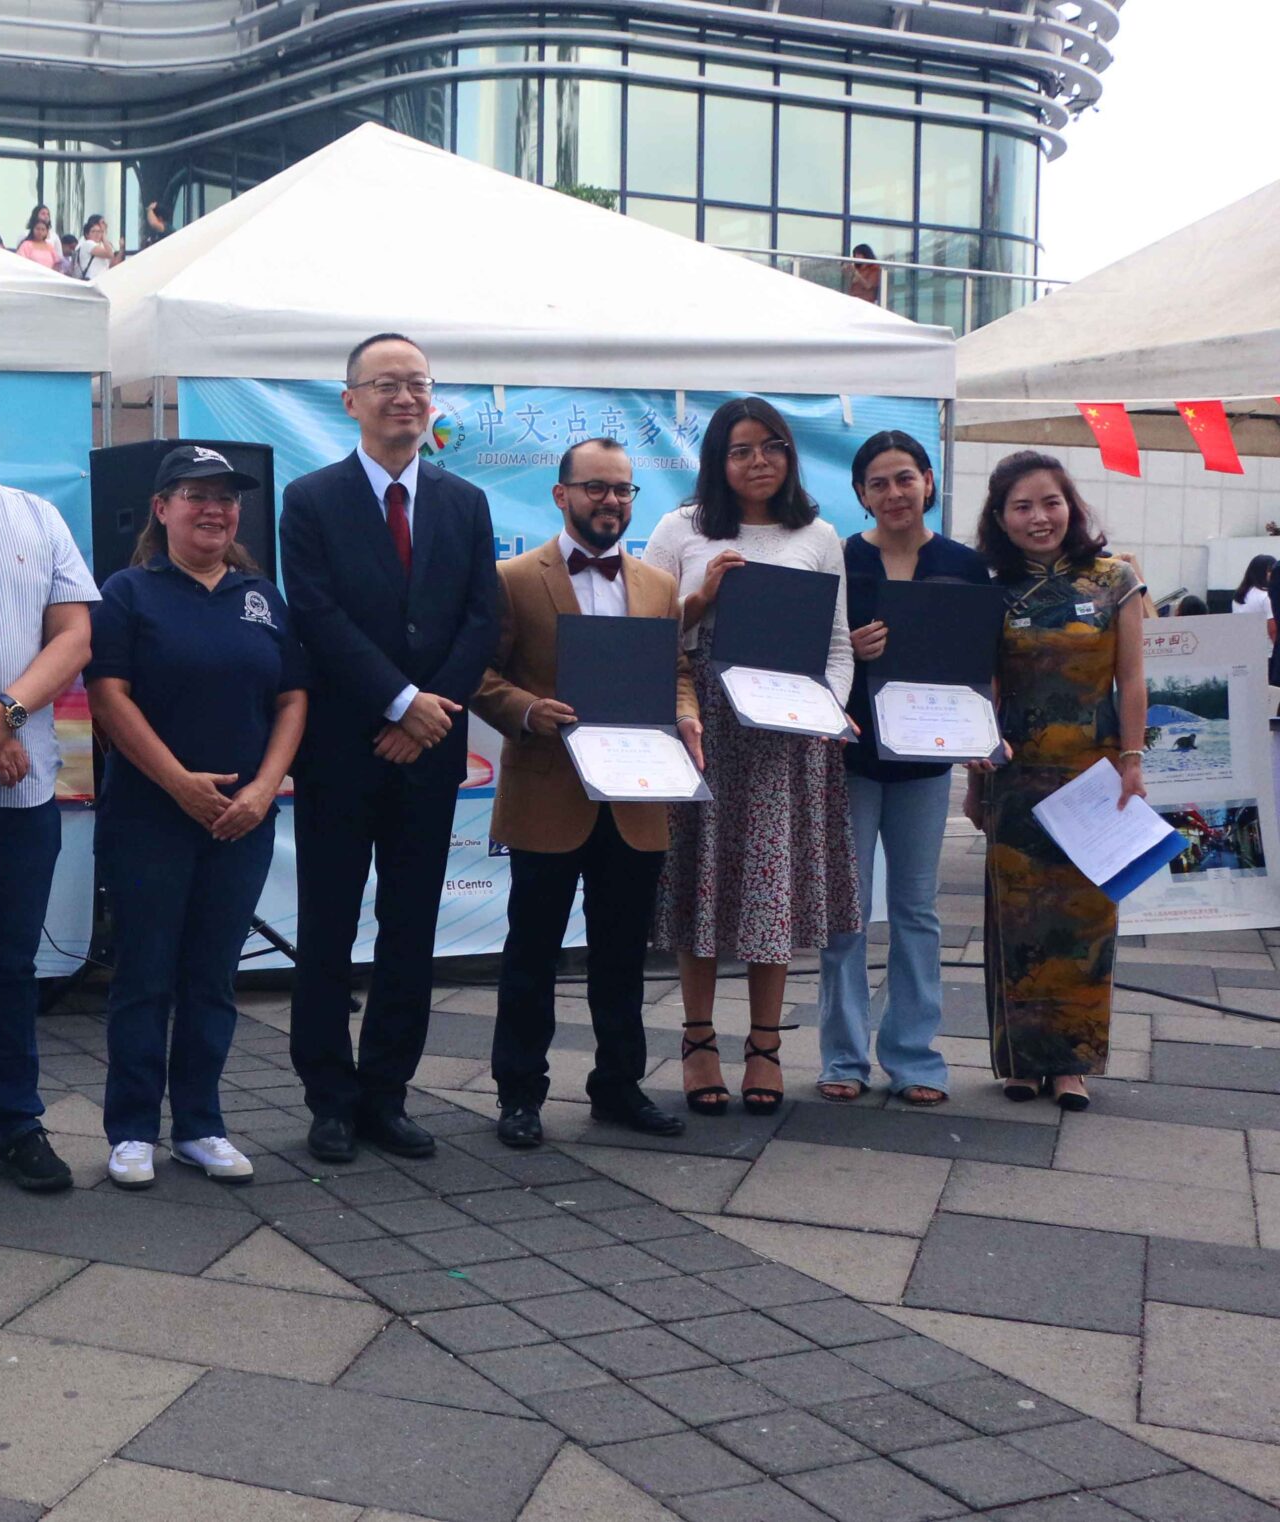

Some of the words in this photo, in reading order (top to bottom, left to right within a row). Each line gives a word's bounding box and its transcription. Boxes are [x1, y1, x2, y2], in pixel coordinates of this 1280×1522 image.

[477, 452, 527, 465] IDIOMA
[531, 453, 564, 466] CHIN
[464, 839, 481, 847] China
[446, 880, 455, 890] El
[457, 879, 493, 890] Centro
